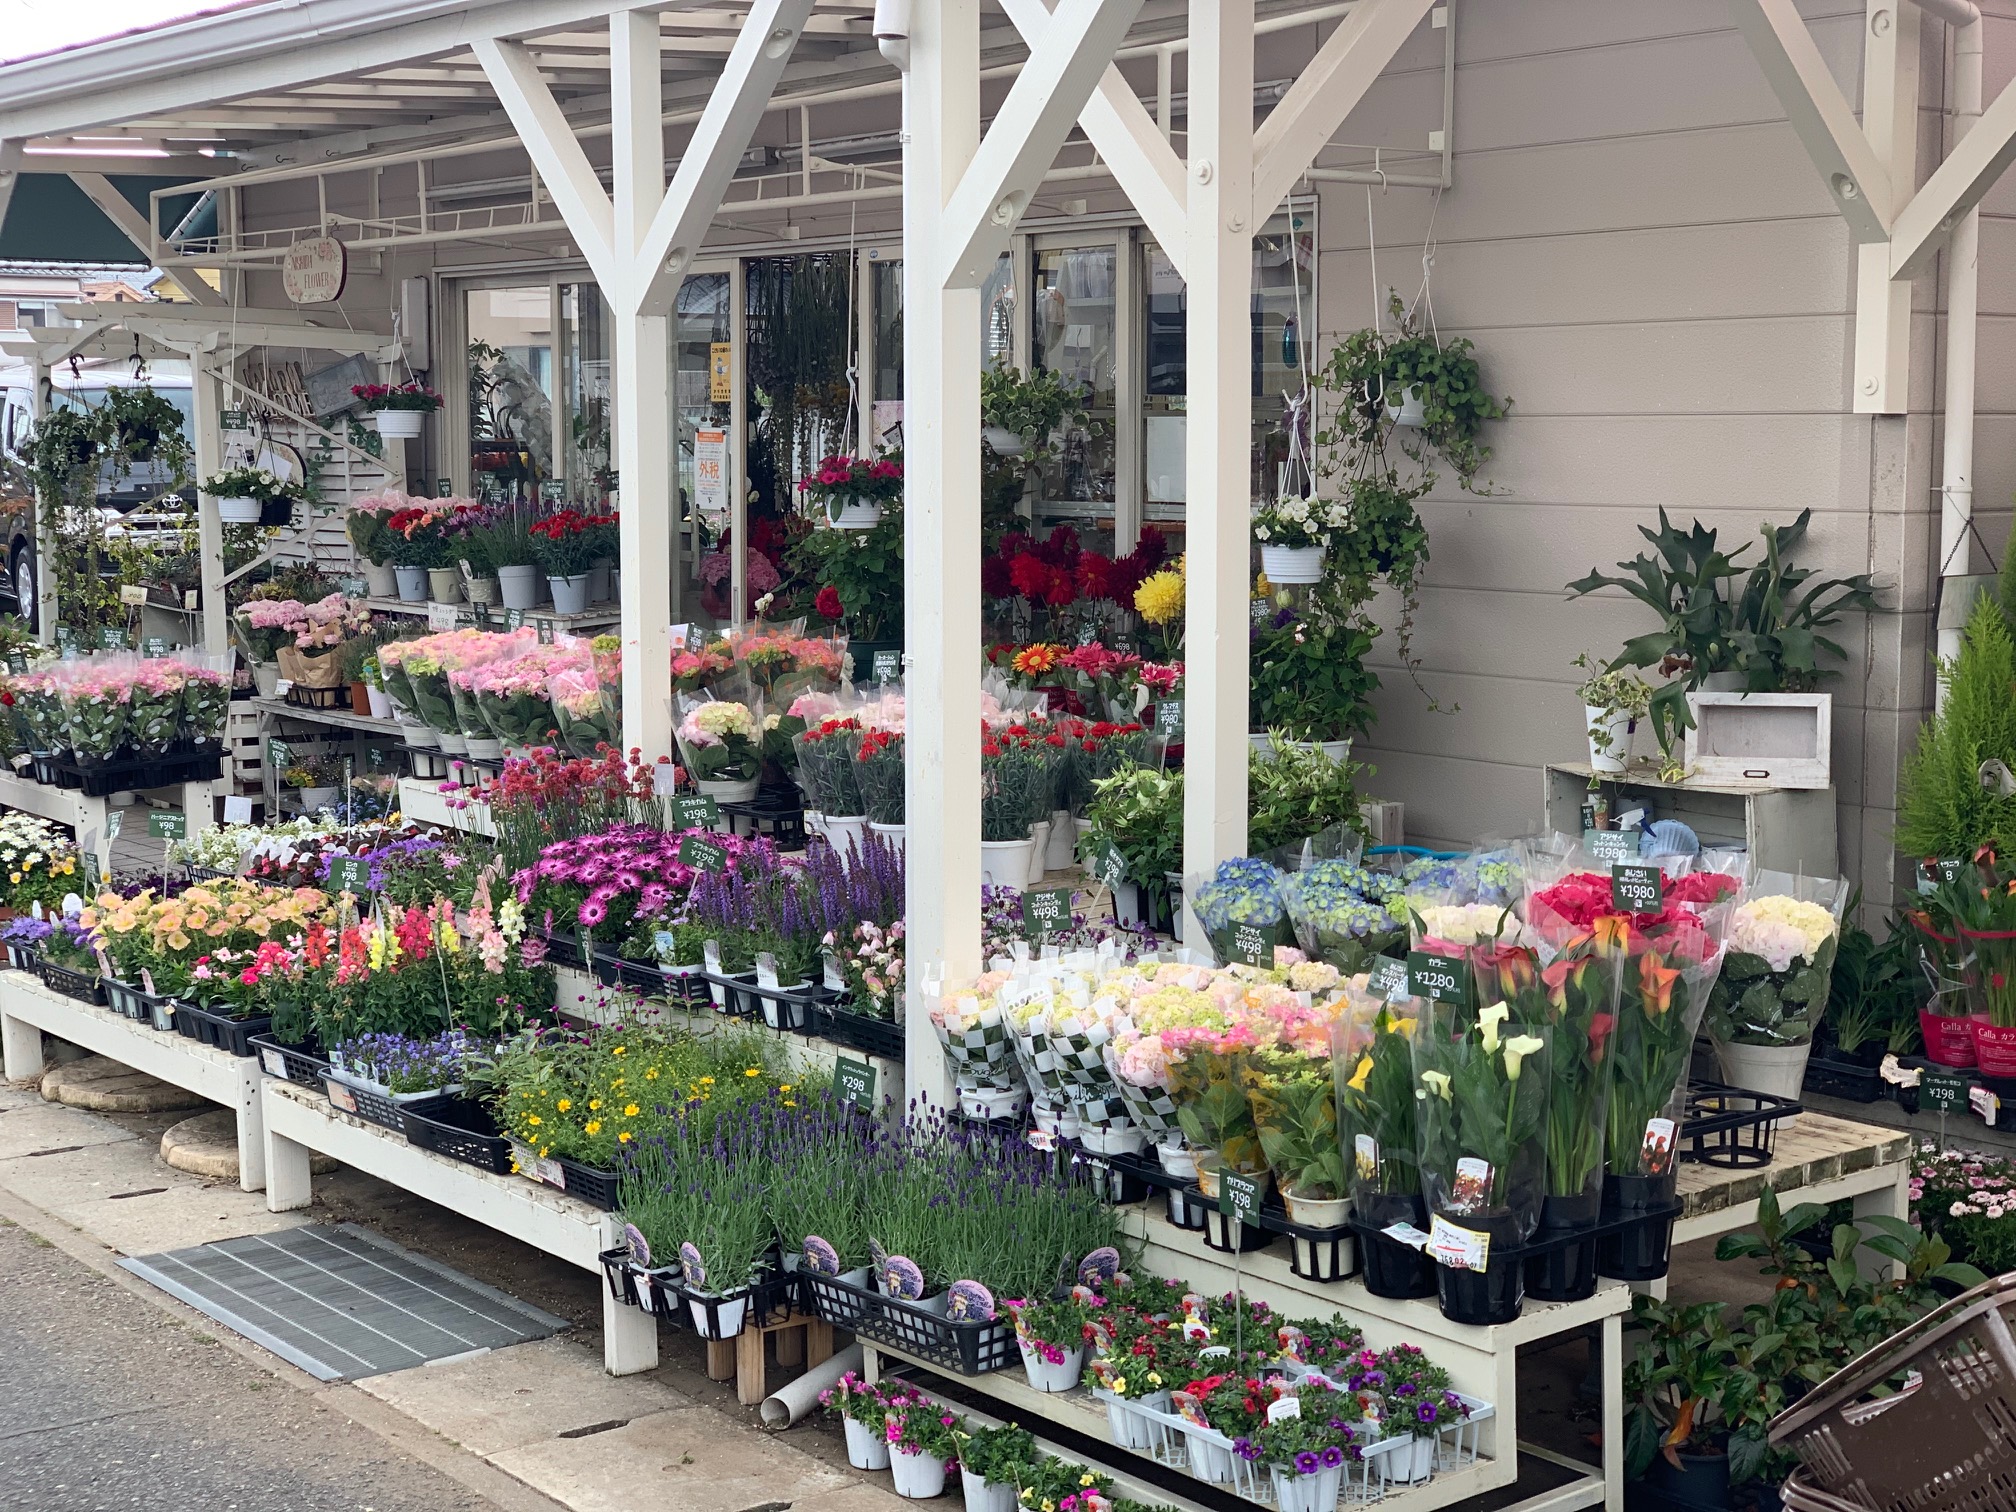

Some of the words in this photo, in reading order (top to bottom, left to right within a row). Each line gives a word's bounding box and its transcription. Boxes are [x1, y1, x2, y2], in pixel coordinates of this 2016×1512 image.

[304, 272, 329, 289] FLOWER
[699, 461, 720, 479] 外税
[1114, 642, 1130, 651] ¥698
[1160, 714, 1179, 725] ¥980
[683, 808, 708, 820] ¥198
[159, 821, 175, 831] ¥98
[1600, 833, 1624, 841] アジサイ
[690, 848, 715, 864] ¥198
[1592, 847, 1628, 859] ¥1980
[1105, 856, 1120, 878] ¥198
[1625, 868, 1647, 877] あじさい
[341, 870, 357, 881] ¥98
[1035, 892, 1056, 901] アジサイ
[1620, 884, 1655, 899] ¥1980
[1031, 900, 1062, 908] コットンキャンディ
[1033, 905, 1059, 919] ¥498
[1240, 925, 1261, 936] アジサイ
[1234, 932, 1266, 945] コットンキャンディ
[1235, 938, 1262, 955] ¥498
[1428, 958, 1447, 967] カラー
[1380, 974, 1406, 993] ¥498
[1414, 970, 1455, 988] ¥1280
[1941, 1021, 1962, 1032] Calla
[1978, 1027, 1997, 1040] Calla
[841, 1074, 865, 1092] ¥298
[1929, 1088, 1955, 1100] ¥198
[1228, 1188, 1251, 1209] ¥198
